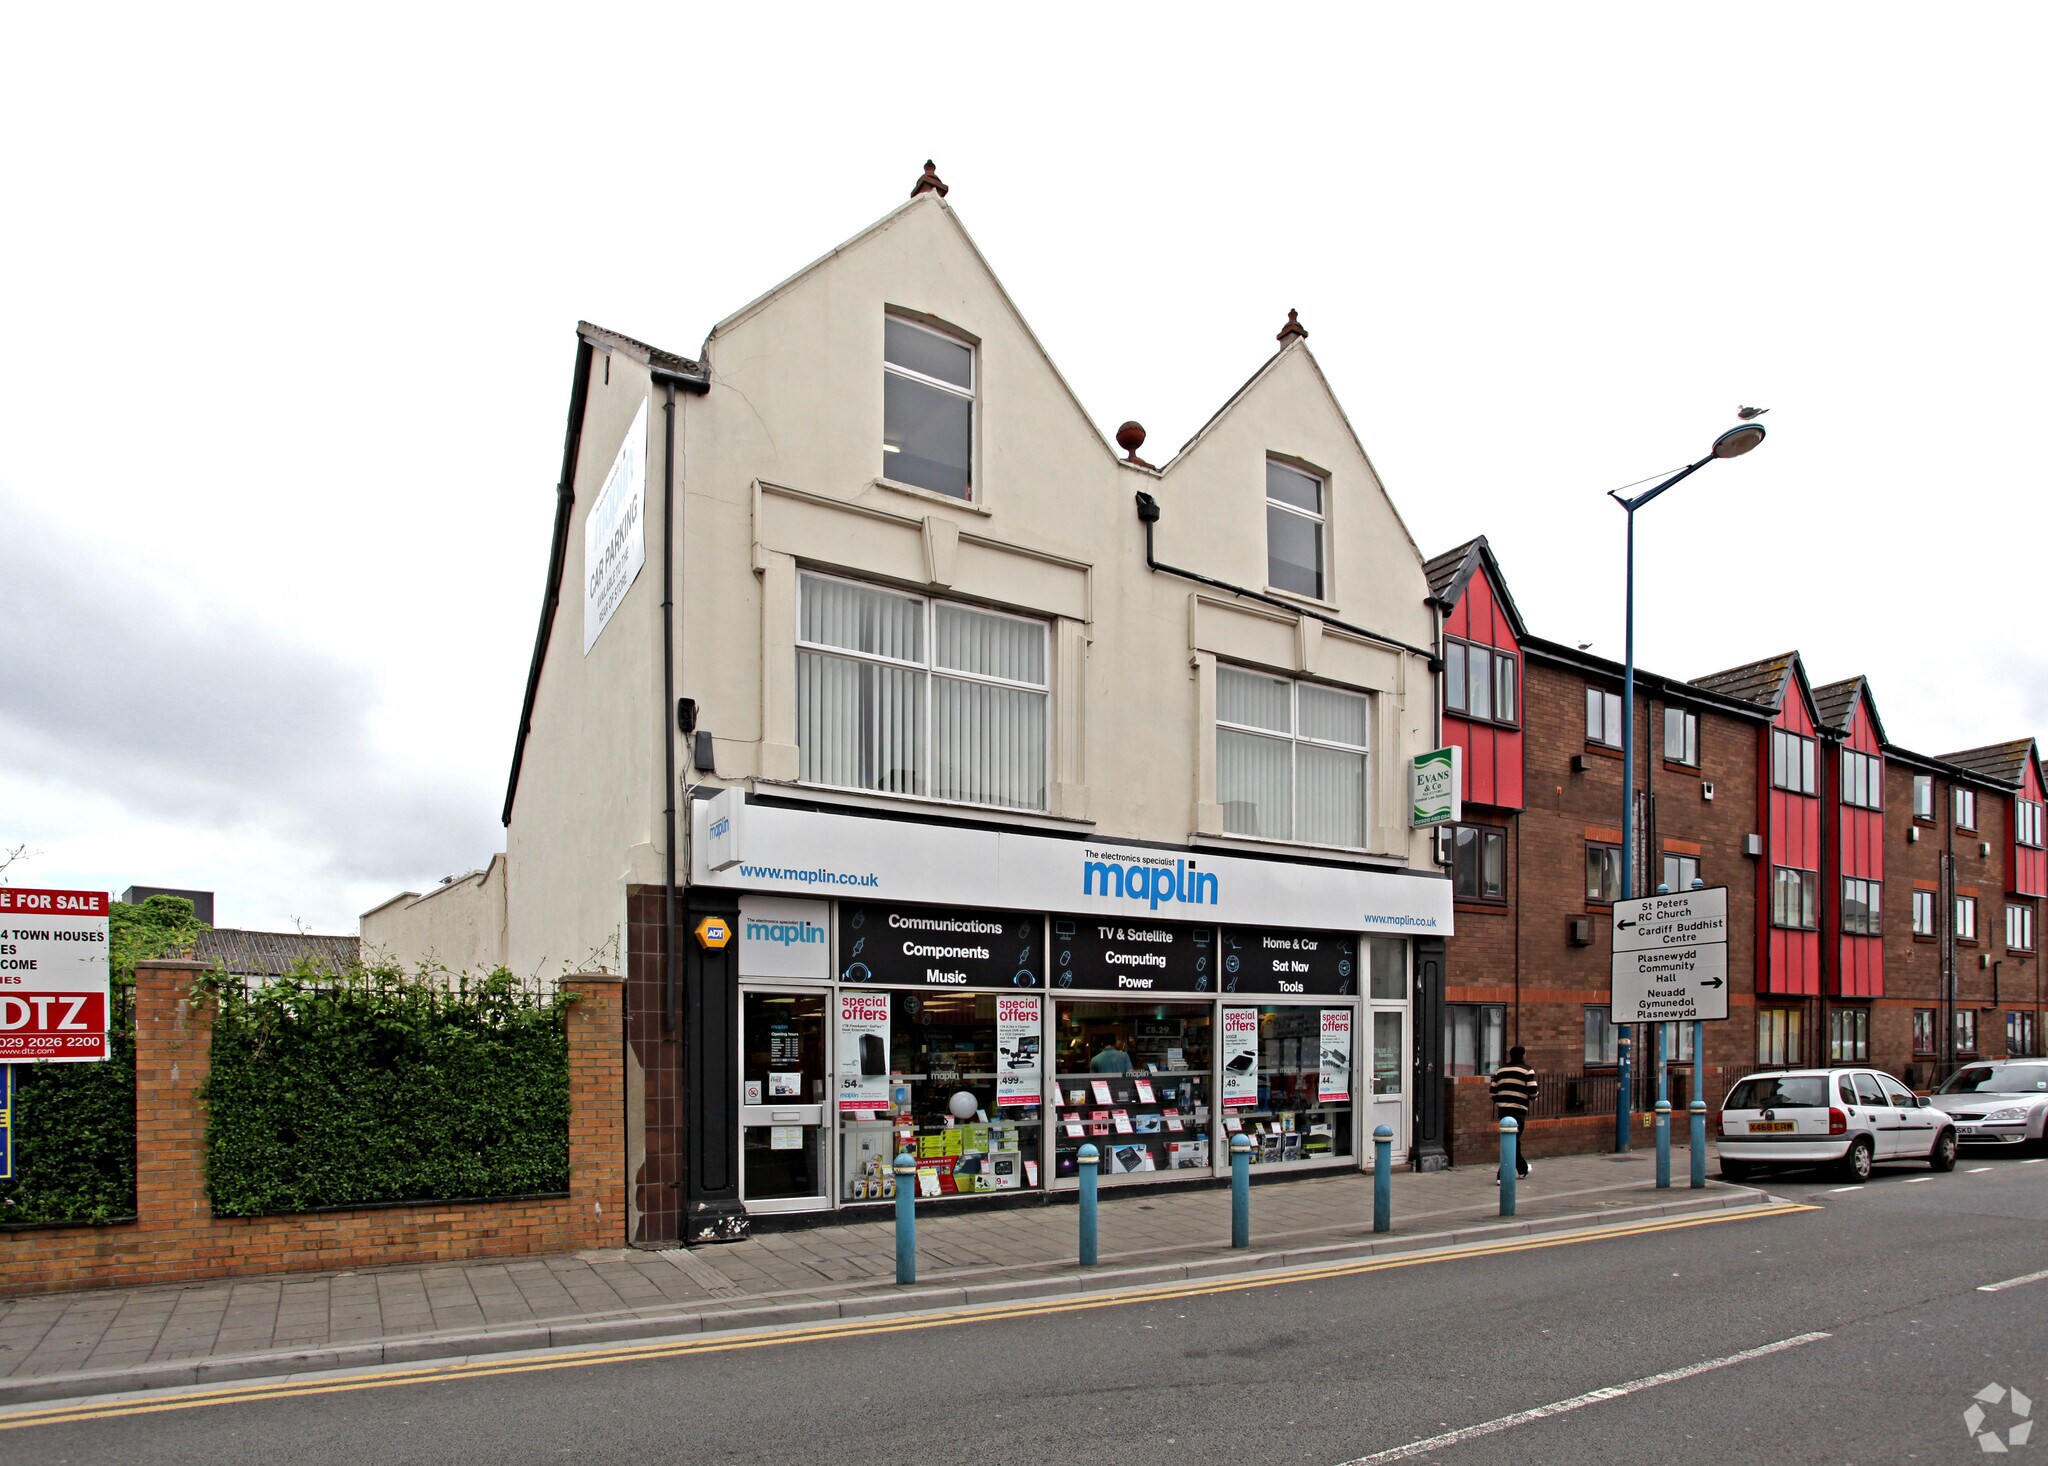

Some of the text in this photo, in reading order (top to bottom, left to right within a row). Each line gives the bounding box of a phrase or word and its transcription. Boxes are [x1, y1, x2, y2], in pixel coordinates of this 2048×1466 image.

[589, 557, 605, 599] CAR
[605, 494, 638, 572] PARKING
[597, 567, 616, 609] AVAILABLE
[598, 600, 610, 625] REAR
[614, 570, 628, 600] STORE
[1417, 770, 1450, 786] EVANS
[709, 816, 730, 841] maplin
[1085, 850, 1175, 866] The electronics specialist
[740, 864, 879, 888] www.maplin.co.uk
[1084, 859, 1218, 911] maplin
[17, 894, 52, 909] FOR
[56, 895, 100, 911] SALE
[1641, 898, 1689, 911] St Peters
[1364, 913, 1437, 928] www.maplin.co.uk
[1638, 908, 1692, 922] RC Church
[888, 913, 1003, 935] Communications
[1638, 919, 1724, 936] Cardiff Buddhist
[12, 930, 50, 941] TOWN
[54, 931, 105, 942] HOUSES
[708, 928, 724, 938] ADT
[746, 921, 825, 947] maplin
[1098, 927, 1174, 943] TV & Satellite
[1662, 933, 1697, 944] Centre
[902, 942, 990, 960] Components
[1263, 937, 1319, 951] Home & Car
[1105, 952, 1167, 969] Computing
[1637, 950, 1697, 964] Plasnewydd
[1272, 960, 1310, 973] Sat Nav
[1638, 961, 1696, 974] Community
[926, 970, 967, 984] Music
[1118, 975, 1154, 989] Power
[1656, 974, 1677, 983] Hall
[1278, 980, 1304, 993] Tools
[1647, 988, 1686, 998] Neuadd
[842, 996, 887, 1008] special
[999, 998, 1038, 1010] special
[1638, 997, 1695, 1009] Gymunedol
[0, 996, 88, 1031] DTZ
[842, 1007, 887, 1021] offers
[999, 1009, 1039, 1021] offers
[1225, 1011, 1255, 1021] special
[1322, 1013, 1349, 1022] special
[1637, 1007, 1697, 1019] Plasnewydd
[1225, 1021, 1256, 1031] offers
[1322, 1021, 1349, 1031] offers
[0, 1037, 100, 1048] 029 2026 2200
[1750, 1122, 1793, 1131] X468 ERW
